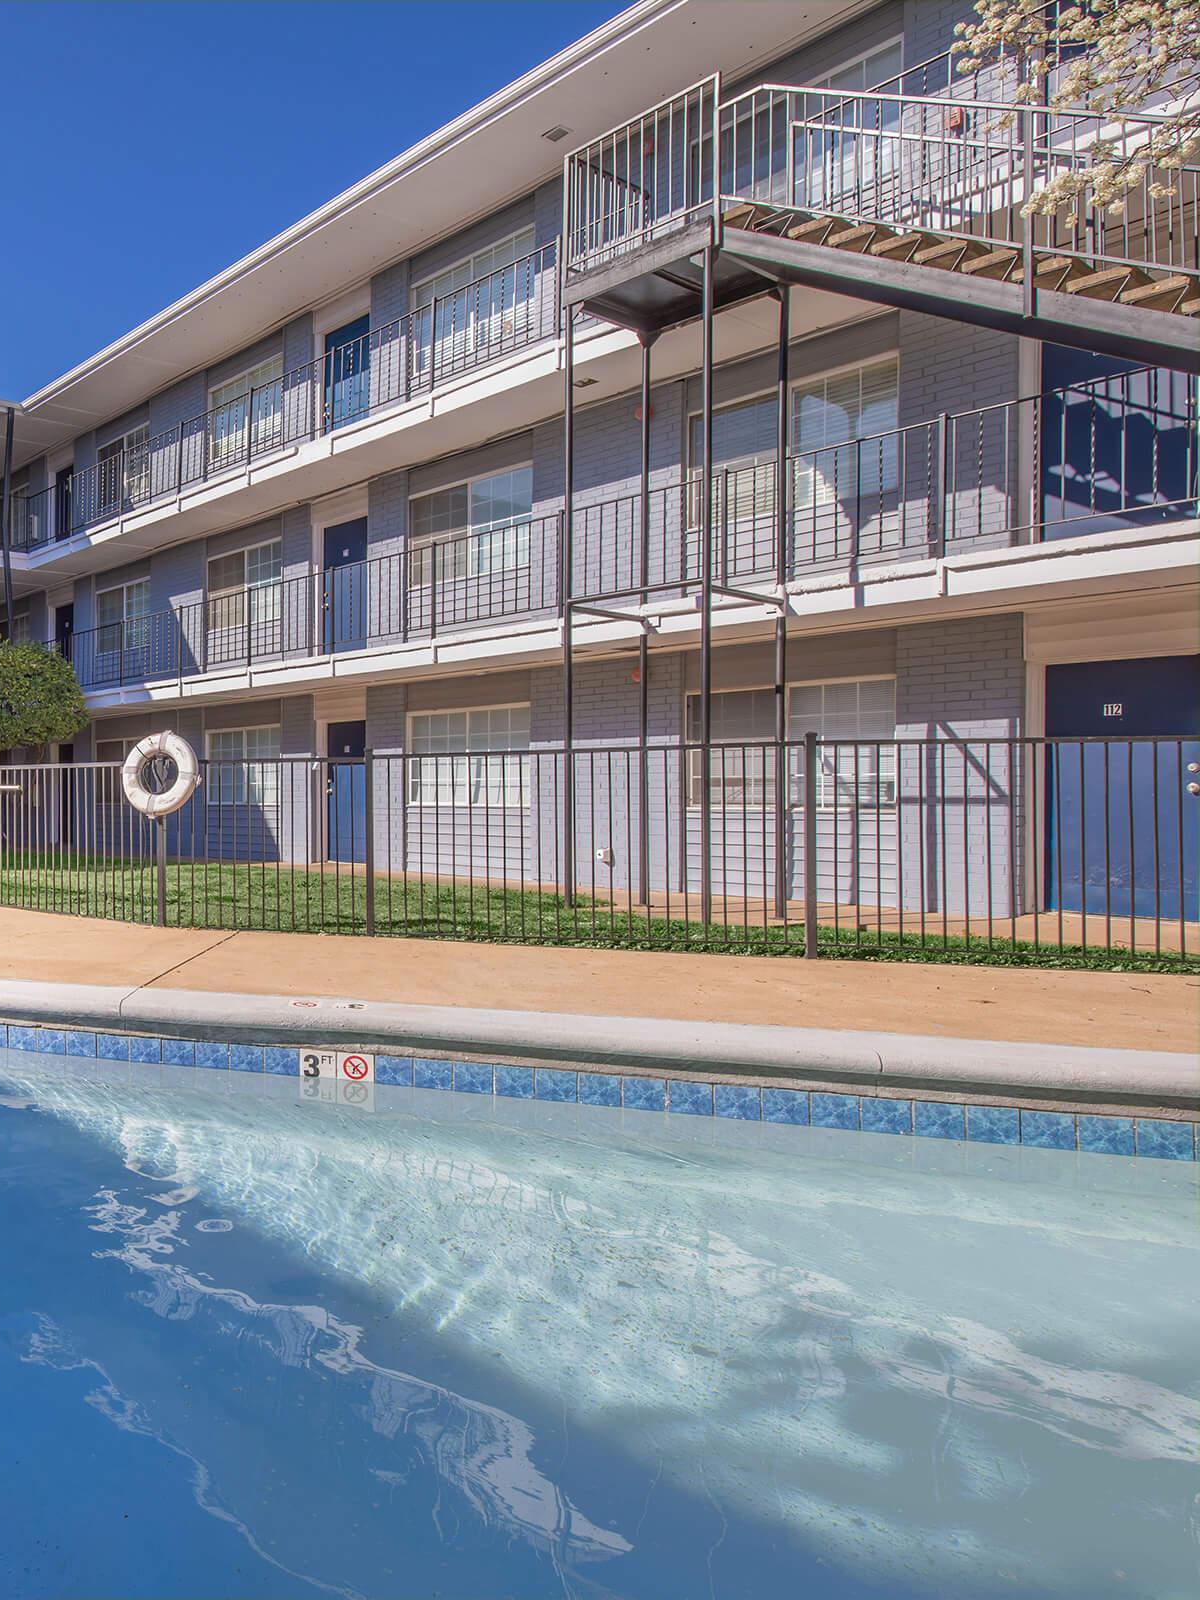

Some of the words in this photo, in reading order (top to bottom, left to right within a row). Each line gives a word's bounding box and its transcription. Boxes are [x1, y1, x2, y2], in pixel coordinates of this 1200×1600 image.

[1105, 704, 1121, 715] 112
[304, 1055, 320, 1077] 3
[321, 1055, 333, 1064] FT
